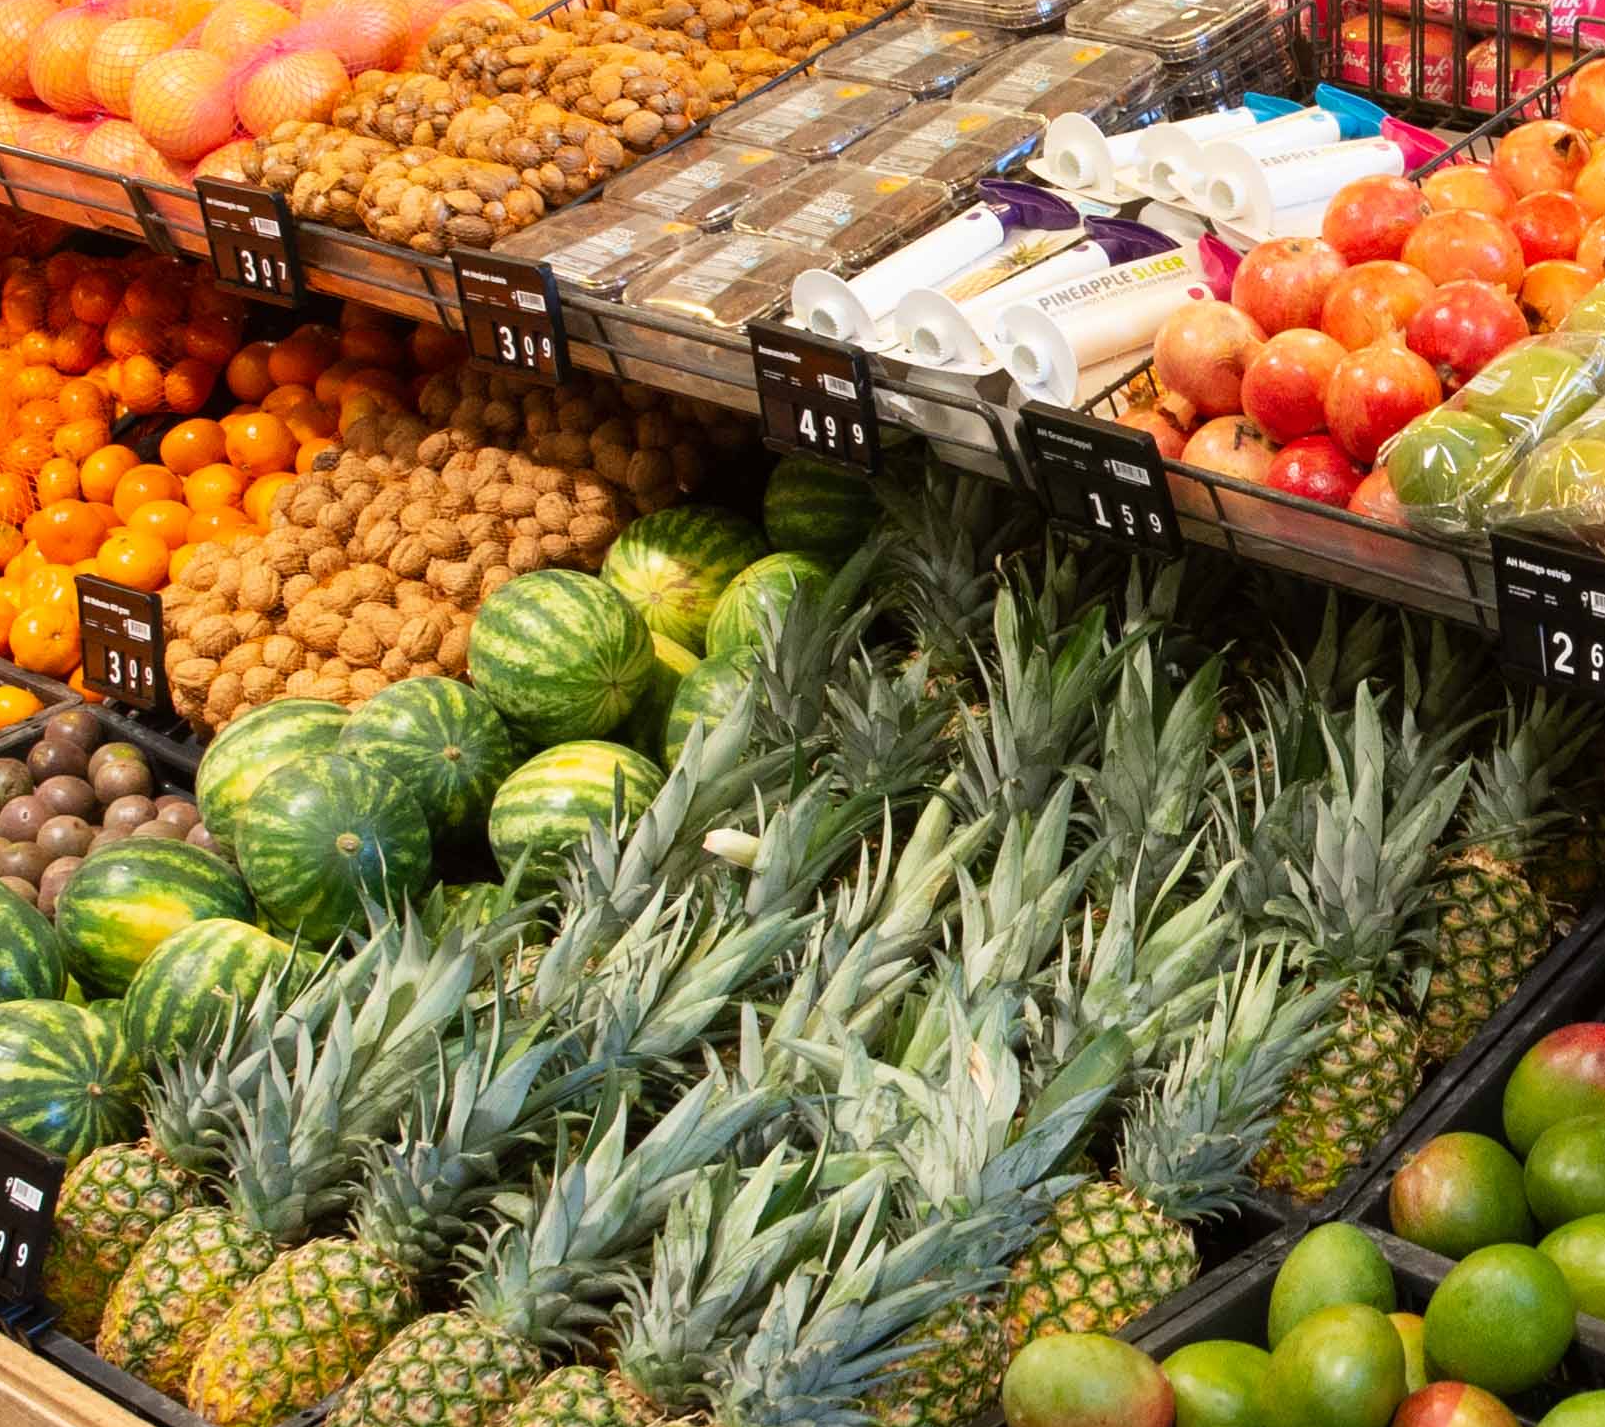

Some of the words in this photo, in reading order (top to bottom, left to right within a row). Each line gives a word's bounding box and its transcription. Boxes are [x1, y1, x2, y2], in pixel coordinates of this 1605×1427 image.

[1393, 57, 1449, 76] Pnk
[1400, 75, 1451, 101] Ldy
[241, 249, 286, 288] 3.07
[1038, 270, 1133, 311] PINEAPPLE
[1131, 255, 1187, 282] SLICER
[499, 325, 551, 367] 3.09
[799, 409, 864, 448] 4.99
[1088, 492, 1162, 535] 1.59
[1505, 556, 1517, 568] AH
[1518, 559, 1545, 575] Mango
[108, 650, 153, 689] 3.09
